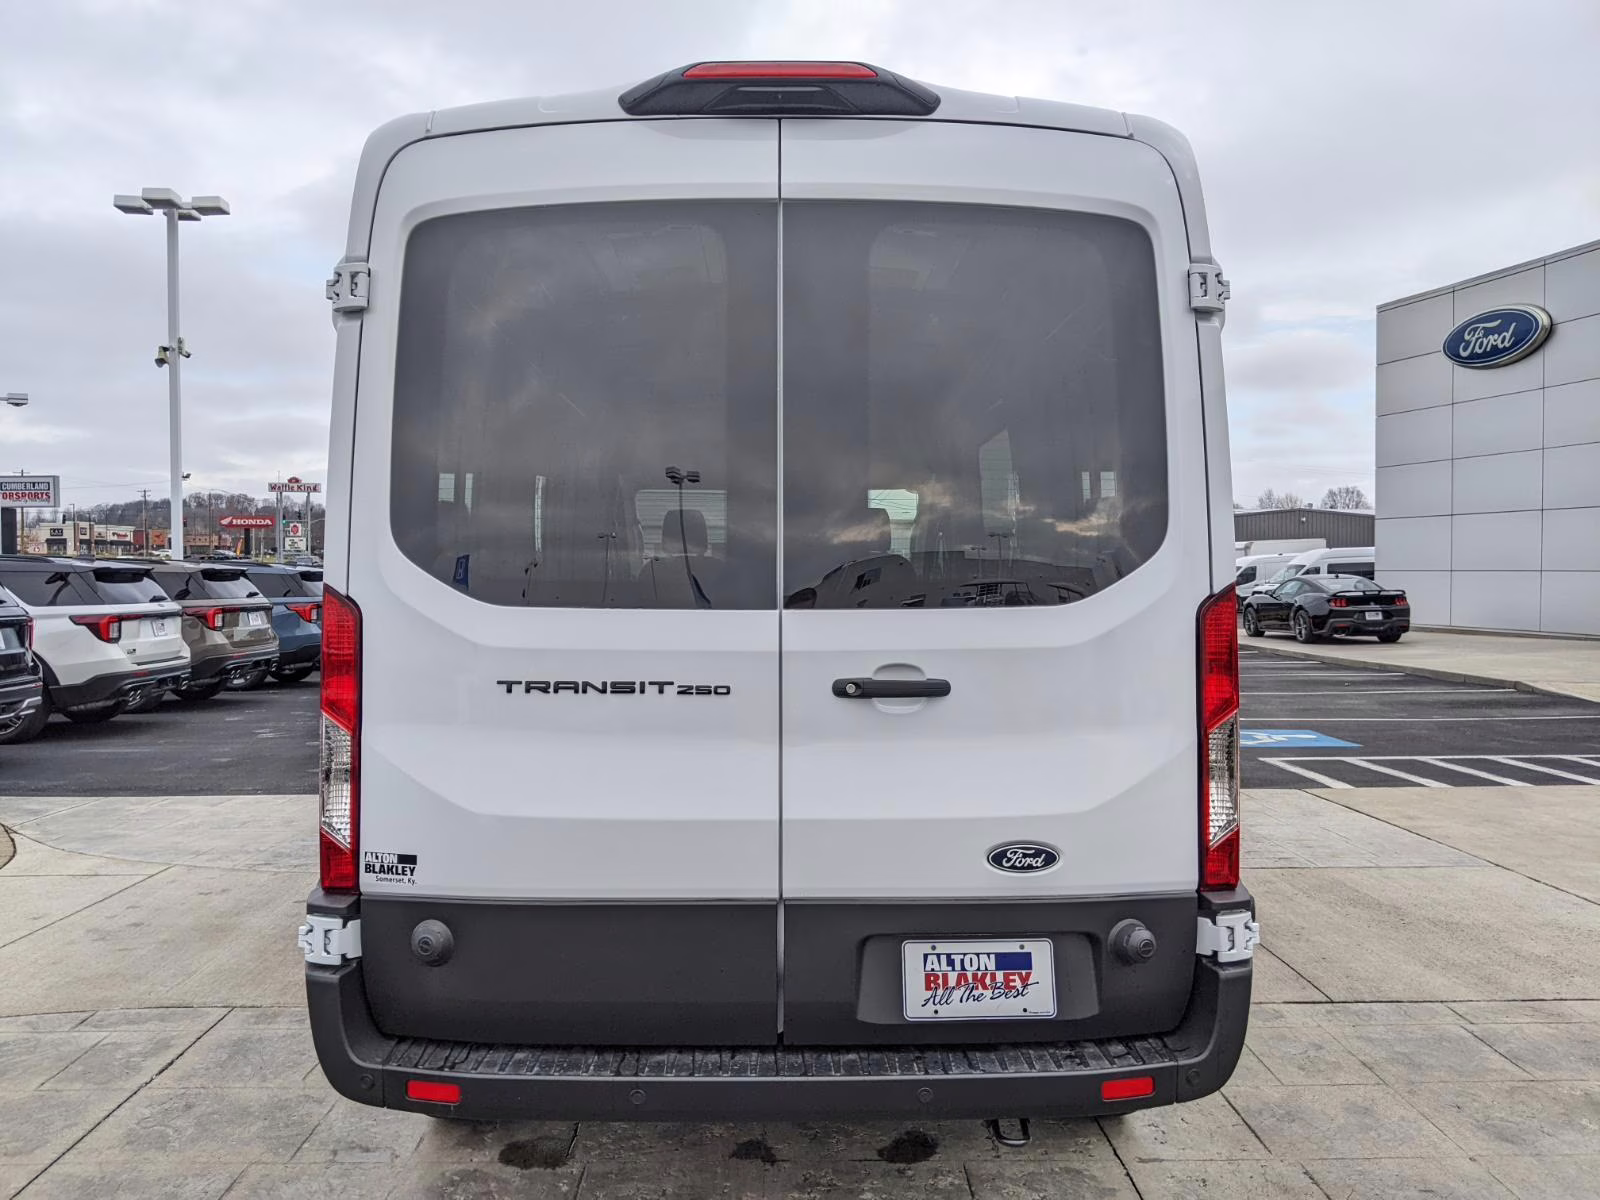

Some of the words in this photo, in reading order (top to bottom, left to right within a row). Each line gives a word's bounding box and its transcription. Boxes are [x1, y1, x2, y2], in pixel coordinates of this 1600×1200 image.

[1459, 319, 1517, 358] Ford
[2, 482, 49, 490] CUMBERLAND
[0, 492, 51, 500] ORSPORTS
[496, 680, 675, 694] TRANSIT
[676, 684, 731, 696] 250
[365, 852, 398, 864] ALTON
[1002, 849, 1045, 867] Ford
[365, 864, 416, 877] BLAKLEY
[375, 875, 407, 884] Somerset,
[924, 953, 996, 971] ALTON
[924, 971, 1033, 992] BLAKLEY
[921, 987, 955, 1007] All
[957, 982, 987, 1004] The
[989, 981, 1039, 1000] Best
